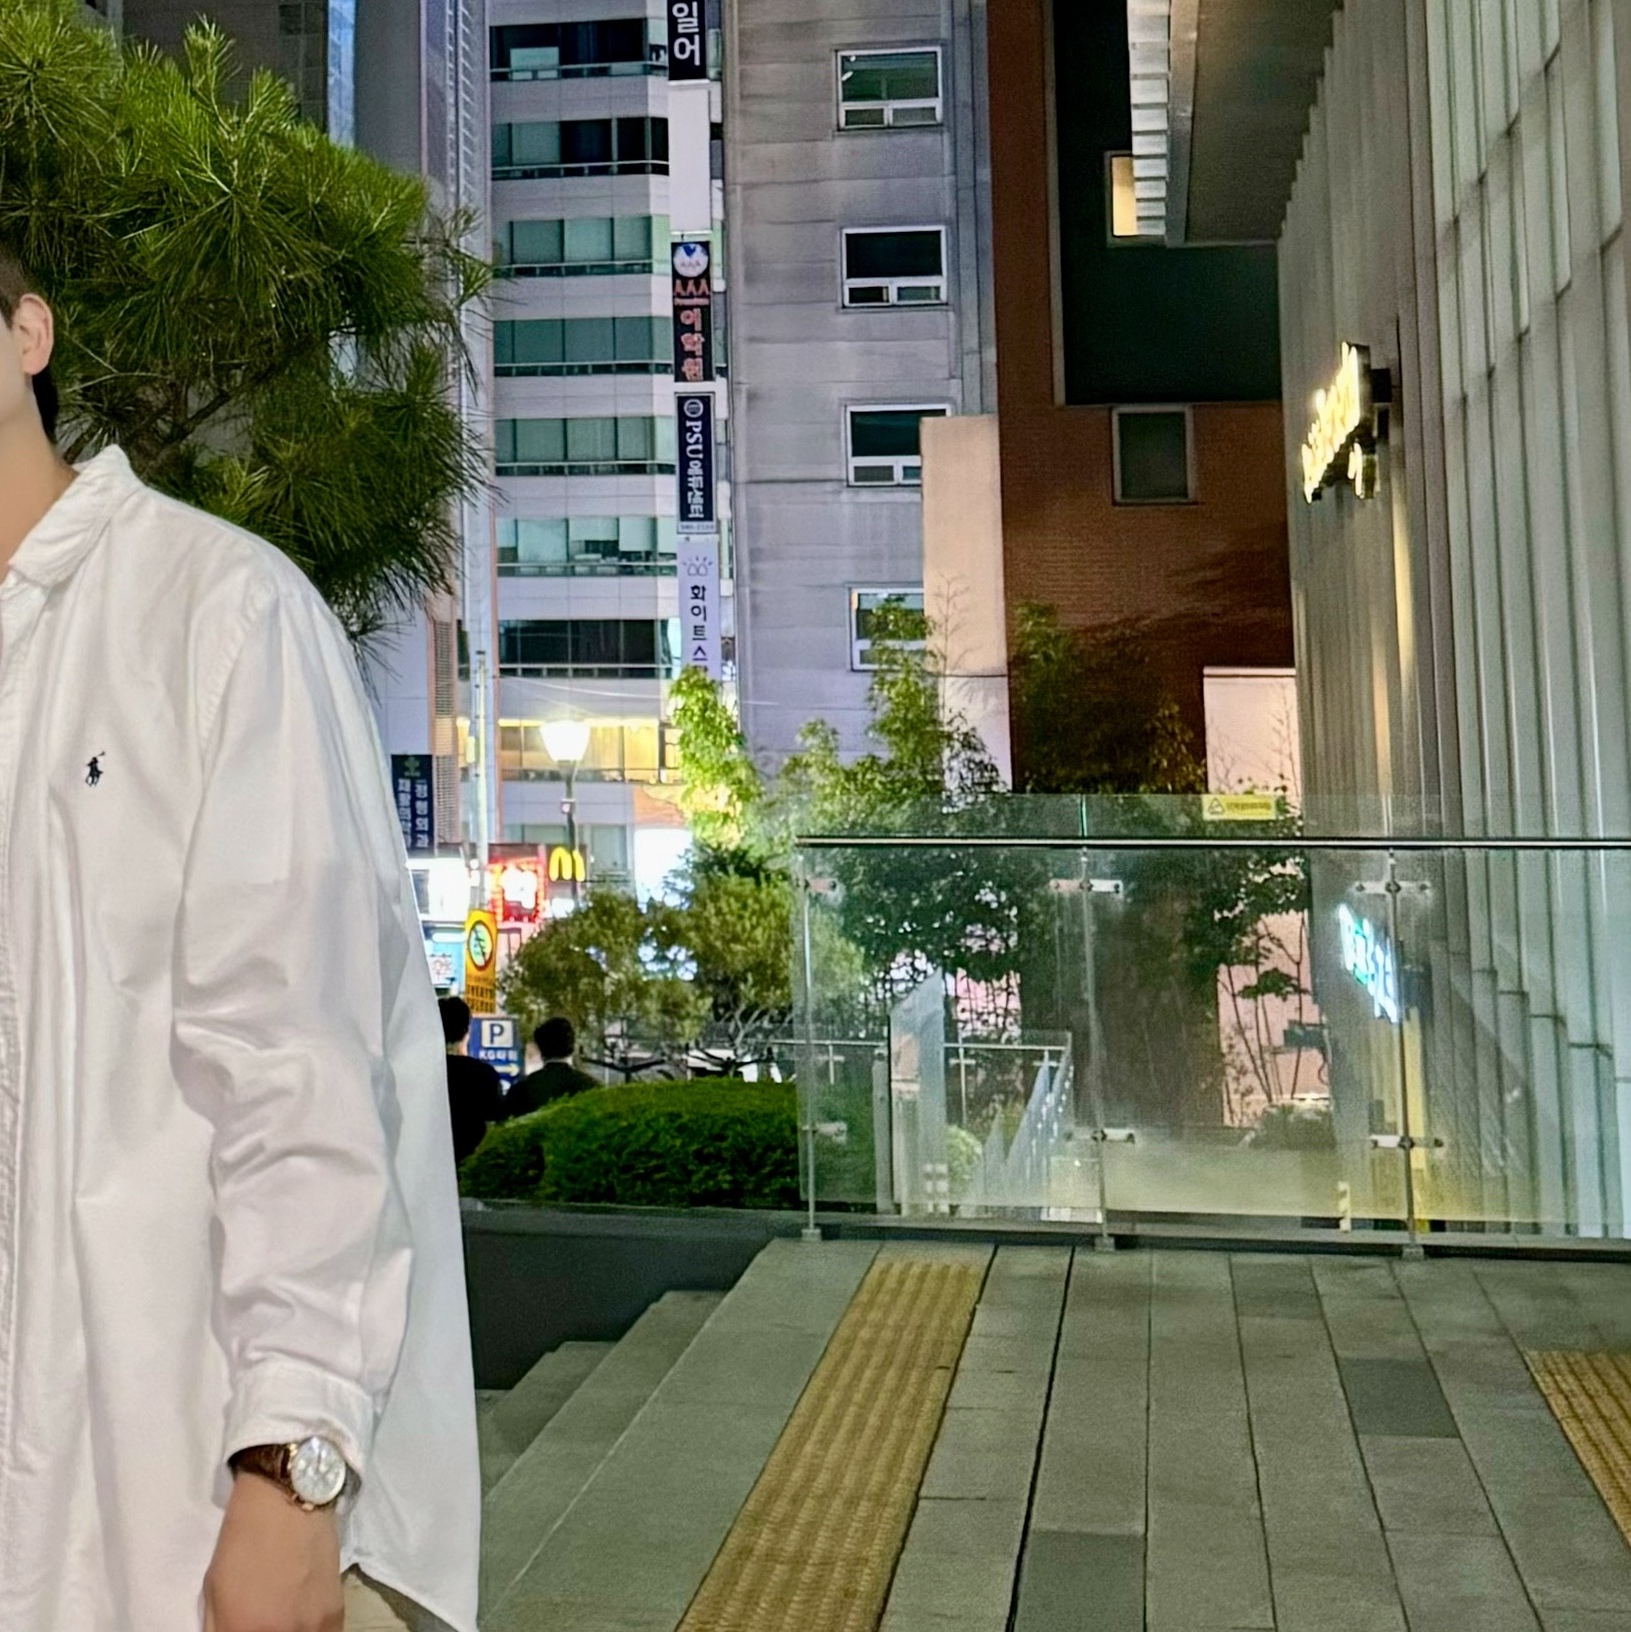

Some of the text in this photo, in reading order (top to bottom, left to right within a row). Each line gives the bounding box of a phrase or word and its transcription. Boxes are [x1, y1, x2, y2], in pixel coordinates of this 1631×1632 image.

[672, 1, 700, 66] 일어
[673, 279, 710, 297] AAA
[489, 1023, 504, 1045] P
